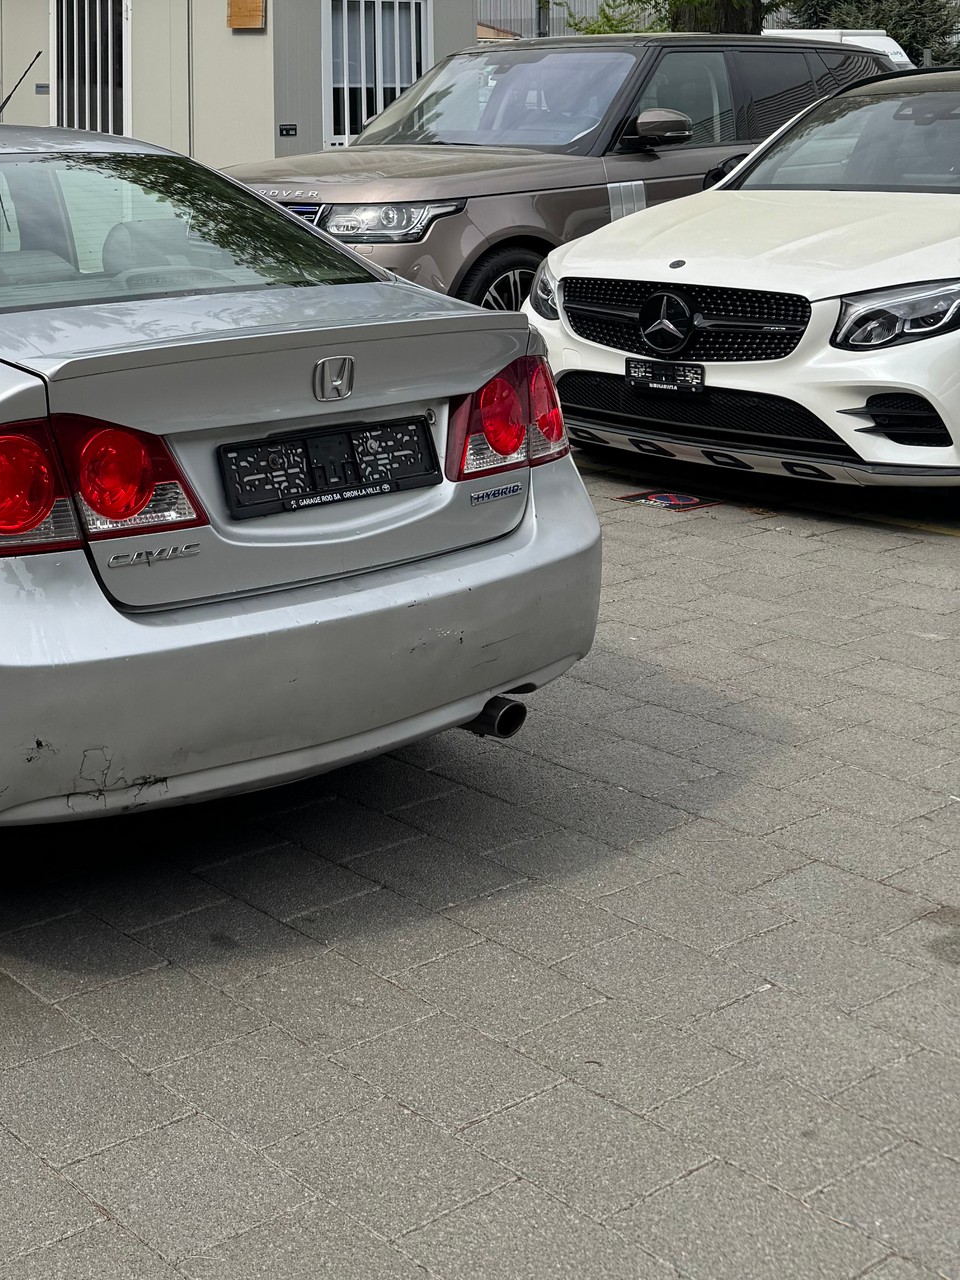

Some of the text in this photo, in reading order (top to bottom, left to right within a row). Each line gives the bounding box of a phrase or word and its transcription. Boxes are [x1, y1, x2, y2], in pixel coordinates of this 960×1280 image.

[298, 486, 381, 506] GARAGE ROD SA ORON-LA-VILLE
[474, 484, 521, 502] HYBRID
[107, 542, 201, 568] CIVIC
